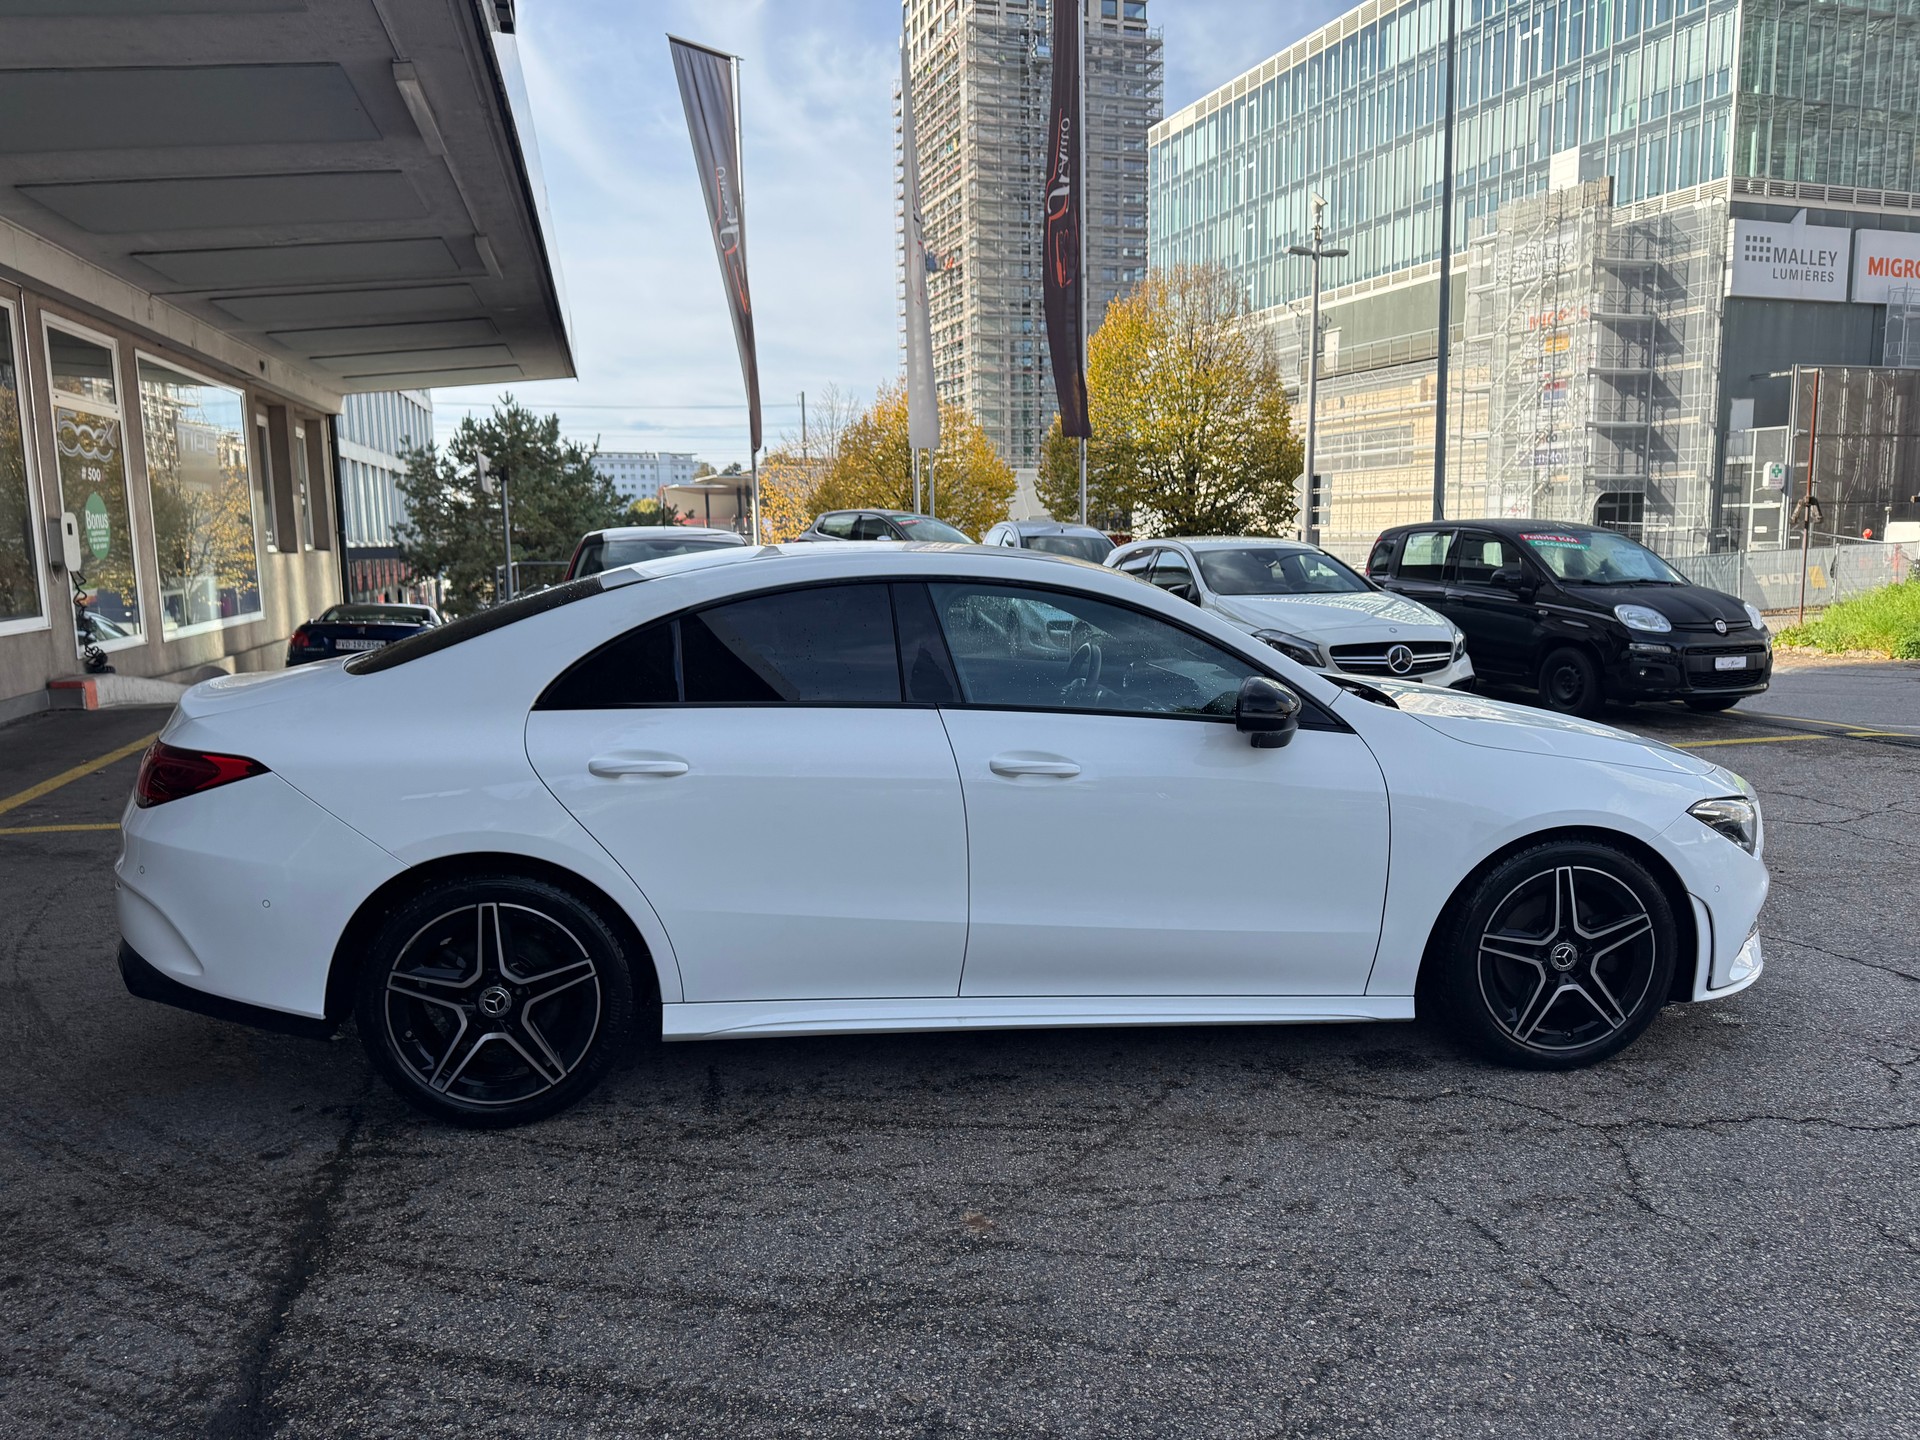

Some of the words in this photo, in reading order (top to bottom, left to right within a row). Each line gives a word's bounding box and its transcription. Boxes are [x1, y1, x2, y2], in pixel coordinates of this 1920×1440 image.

[1773, 247, 1838, 267] MALLEY
[1772, 267, 1835, 283] LUMIÈRES
[85, 510, 109, 530] Bonus
[1534, 540, 1585, 550] Occasion
